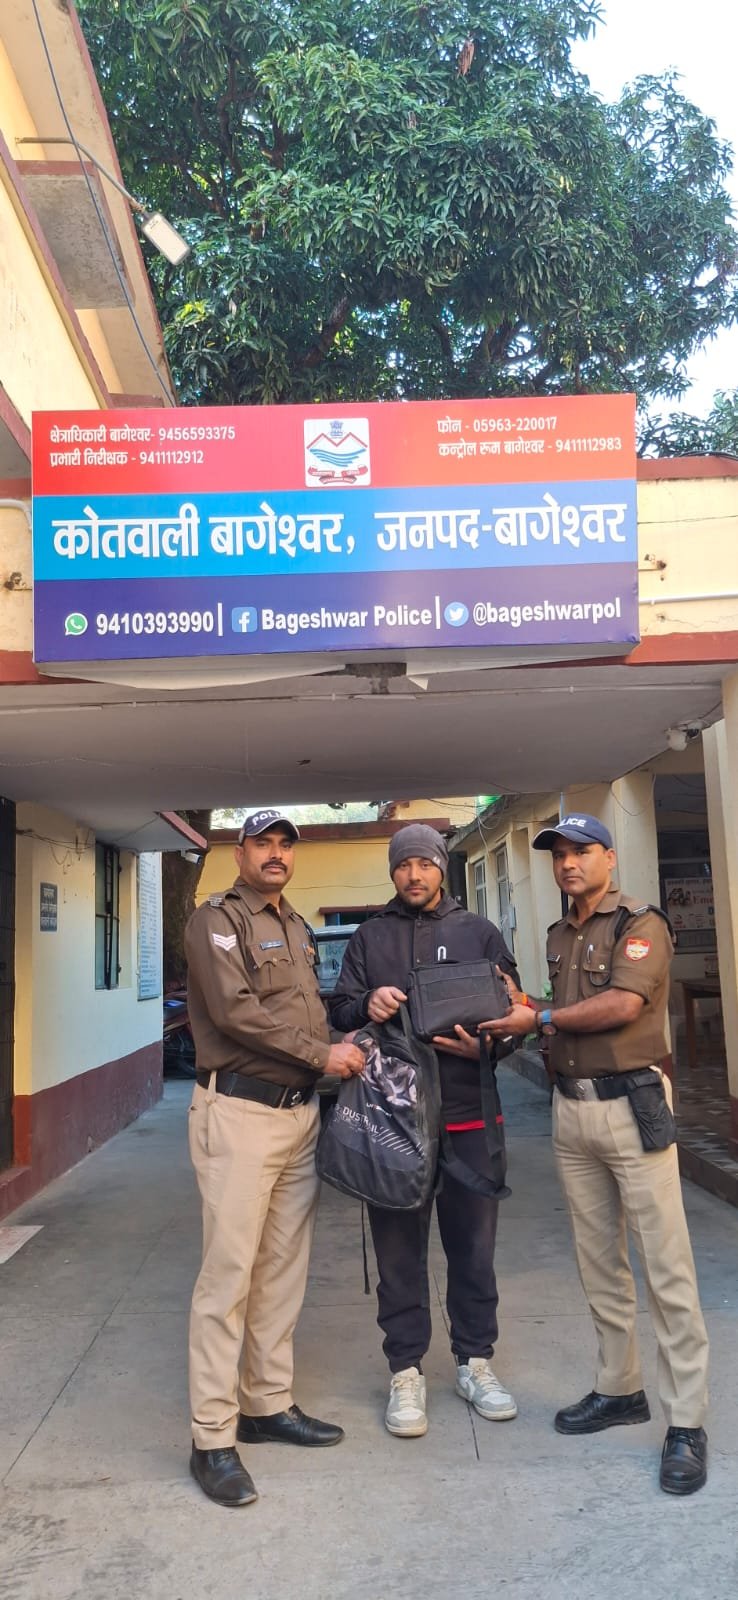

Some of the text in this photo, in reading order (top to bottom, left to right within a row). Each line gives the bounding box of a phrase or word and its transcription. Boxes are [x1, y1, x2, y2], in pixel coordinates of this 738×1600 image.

[50, 425, 106, 442] क्षेत्राधिकारी
[159, 427, 236, 441] 9456593375
[437, 416, 462, 433] फोन
[473, 417, 557, 432] 05963-220017
[480, 441, 500, 455] रूम
[504, 436, 545, 455] बागेश्वर
[555, 437, 622, 453] 9411112983
[50, 448, 81, 466] प्रभारी
[84, 448, 128, 465] निरीक्षक
[140, 450, 204, 465] 9411112912
[52, 493, 627, 558] कोतवाली बागेश्वर, जनपद-बागेश्वर
[262, 605, 432, 633] Bageshwar Police
[473, 598, 621, 626] @bageshwarpol
[97, 611, 214, 635] 9410393990
